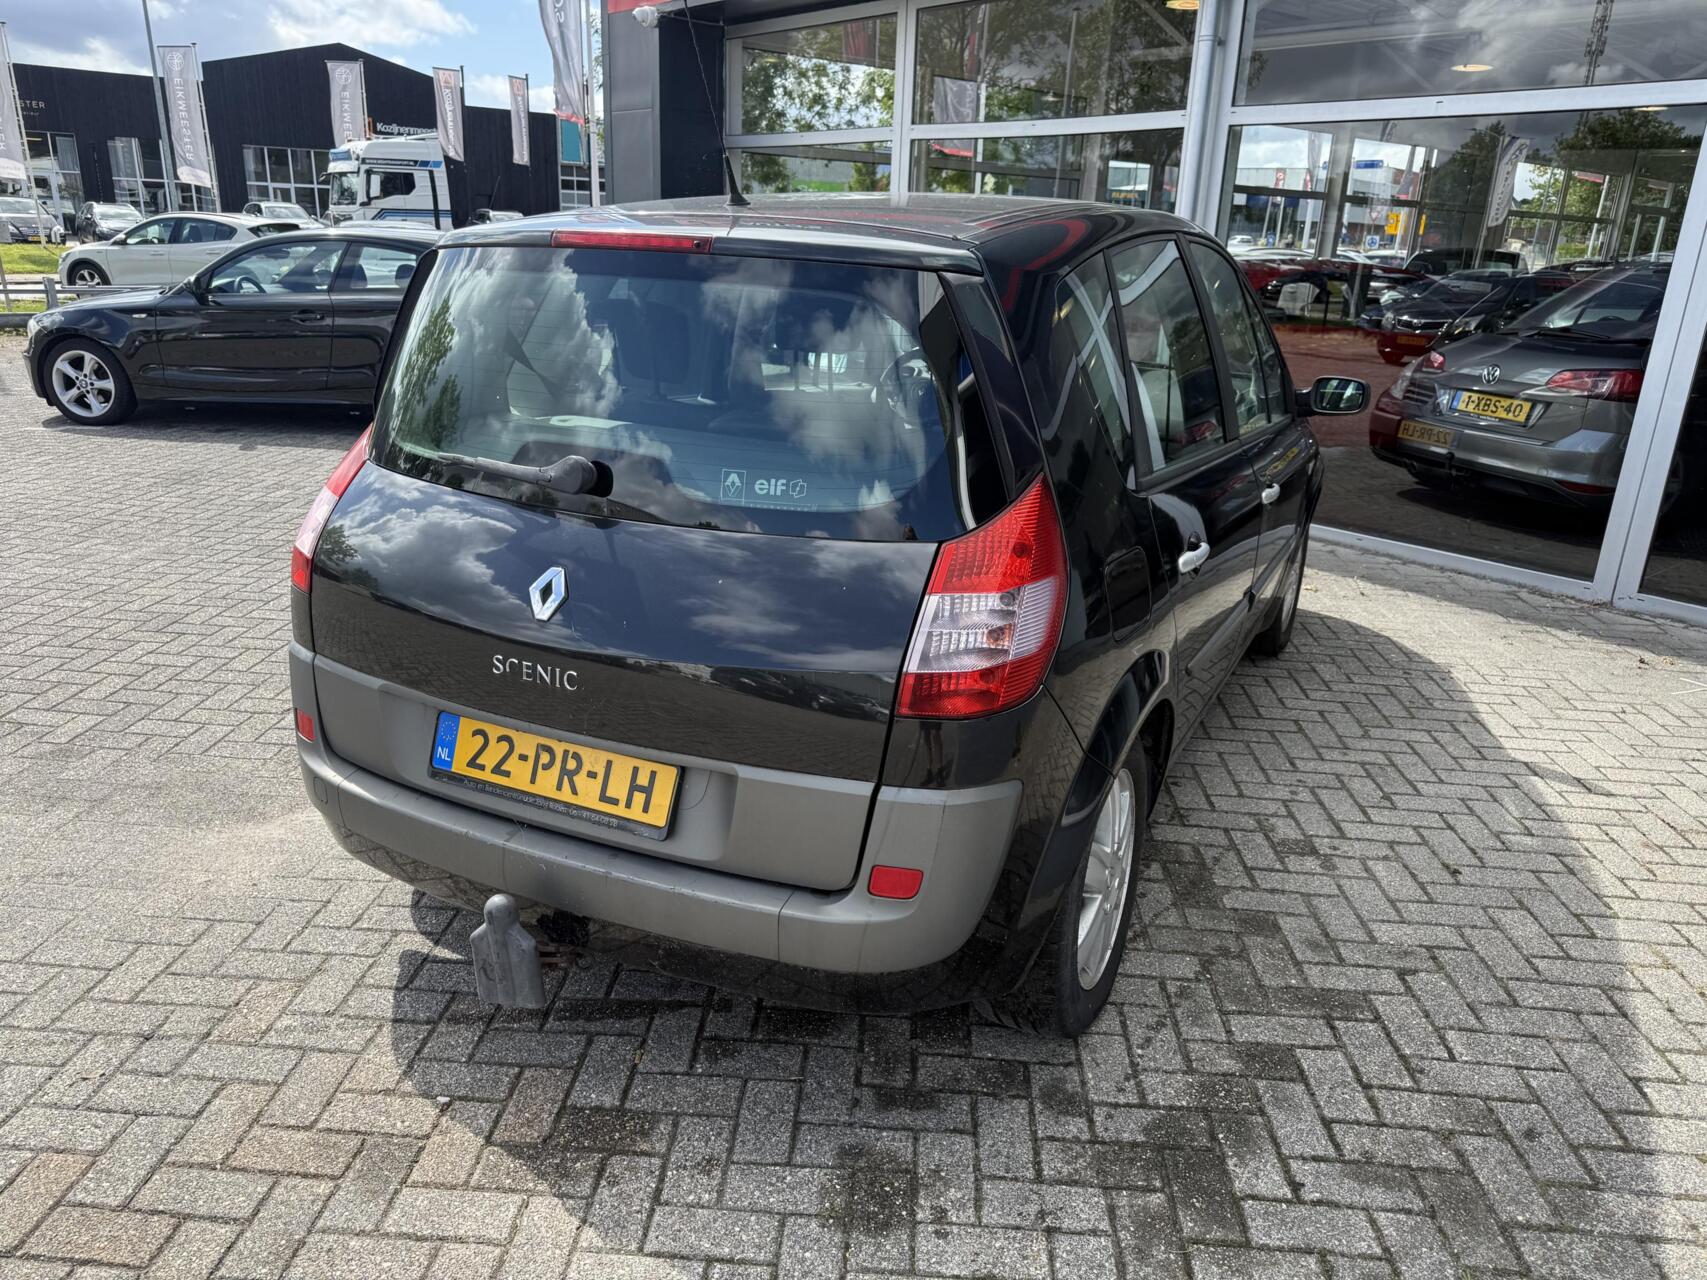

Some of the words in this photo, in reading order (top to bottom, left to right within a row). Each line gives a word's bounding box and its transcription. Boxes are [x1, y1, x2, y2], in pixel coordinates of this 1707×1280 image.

[1464, 394, 1524, 418] 1-XBS-40
[754, 478, 787, 496] elf
[492, 654, 578, 691] SCENIC
[436, 745, 451, 762] NL
[466, 728, 657, 814] 22-PR-LH
